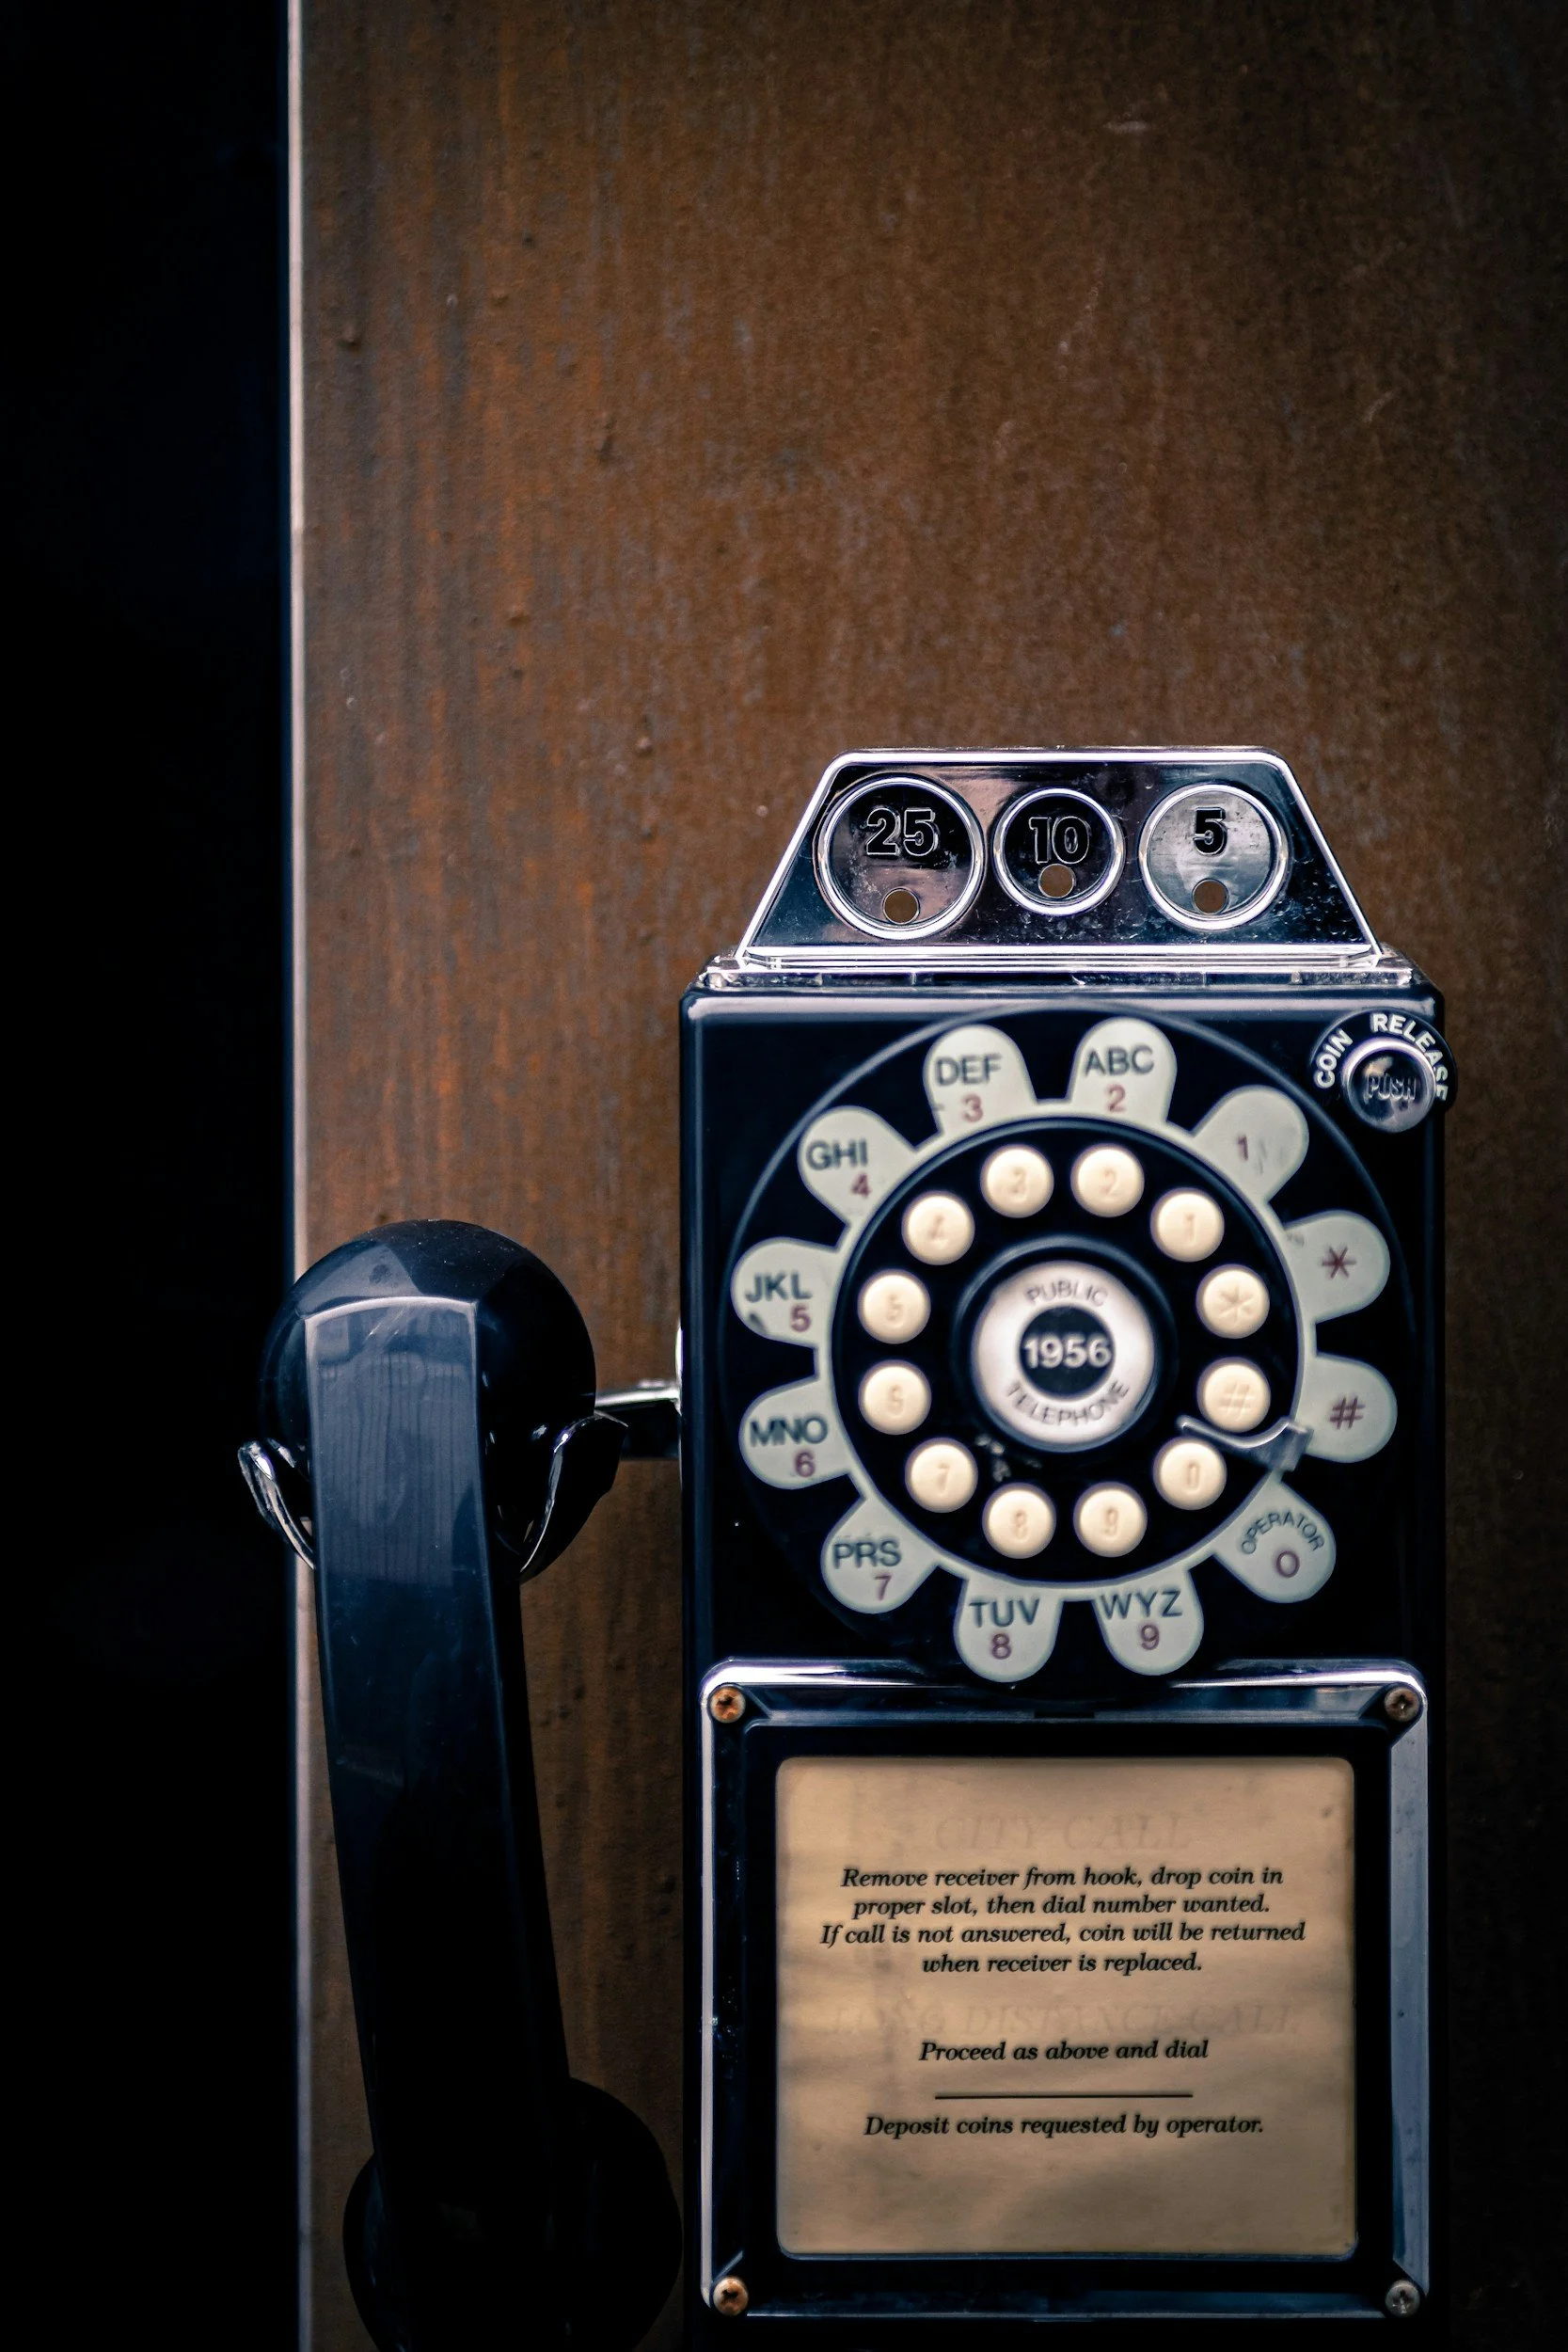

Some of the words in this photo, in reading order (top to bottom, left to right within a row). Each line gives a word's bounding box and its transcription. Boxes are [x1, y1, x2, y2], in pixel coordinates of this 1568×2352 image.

[864, 806, 938, 857] 25
[1029, 816, 1089, 865] 10
[1193, 806, 1226, 855] 5
[934, 1052, 1003, 1087] DEF
[1084, 1044, 1155, 1076] ABC
[1312, 1027, 1354, 1089] COIN
[1371, 1012, 1449, 1102] RELEASE
[1106, 1084, 1127, 1112] 2
[1366, 1073, 1418, 1102] PUSH
[961, 1094, 984, 1122] 3
[806, 1138, 868, 1170] GHI
[1236, 1134, 1249, 1162] 1
[850, 1173, 871, 1198] 4
[744, 1272, 814, 1303] JKL
[1026, 1279, 1108, 1308] PUBLIC
[789, 1303, 813, 1333] 5
[1022, 1331, 1114, 1369] 1956
[1006, 1380, 1131, 1426] TELEPHONE
[749, 1414, 829, 1447] MNO
[794, 1448, 816, 1478] 6
[1239, 1510, 1325, 1555] OPERATOR
[832, 1539, 902, 1569] PRS
[874, 1573, 894, 1601] 7
[967, 1597, 1041, 1629] TUV
[1099, 1590, 1182, 1620] WYZ
[990, 1632, 1013, 1661] 8
[1139, 1624, 1160, 1651] 9
[840, 1867, 928, 1887] Remove
[934, 1867, 1021, 1886] receiver
[1022, 1866, 1077, 1891] from
[1083, 1866, 1143, 1888] hook,
[1149, 1865, 1202, 1890] drop
[1207, 1867, 1256, 1885] coin
[1260, 1866, 1284, 1884] in
[851, 1899, 927, 1920] proper
[930, 1894, 978, 1917] slot,
[986, 1894, 1037, 1915] then
[1041, 1893, 1086, 1915] dial
[1092, 1893, 1178, 1914] number
[1182, 1892, 1270, 1914] wanted.
[819, 1924, 844, 1949] If
[844, 1923, 886, 1944] call
[892, 1925, 911, 1944] is
[917, 1926, 955, 1944] not
[960, 1921, 1071, 1946] answered,
[1078, 1923, 1126, 1942] coin
[1132, 1920, 1174, 1942] will
[1179, 1920, 1205, 1942] be
[1210, 1920, 1307, 1942] returned
[922, 1953, 981, 1973] when
[987, 1954, 1072, 1973] receiver
[1078, 1953, 1098, 1972] is
[1103, 1951, 1202, 1977] replaced.
[918, 2041, 1006, 2061] Proceed
[1011, 2045, 1039, 2061] as
[1044, 2040, 1110, 2060] above
[1114, 2039, 1160, 2059] and
[1164, 2039, 1210, 2059] dial
[863, 2114, 950, 2140] Deposit
[956, 2116, 1014, 2135] coins
[1020, 2112, 1128, 2139] requested
[1132, 2112, 1160, 2138] by
[1165, 2115, 1264, 2138] operator.
